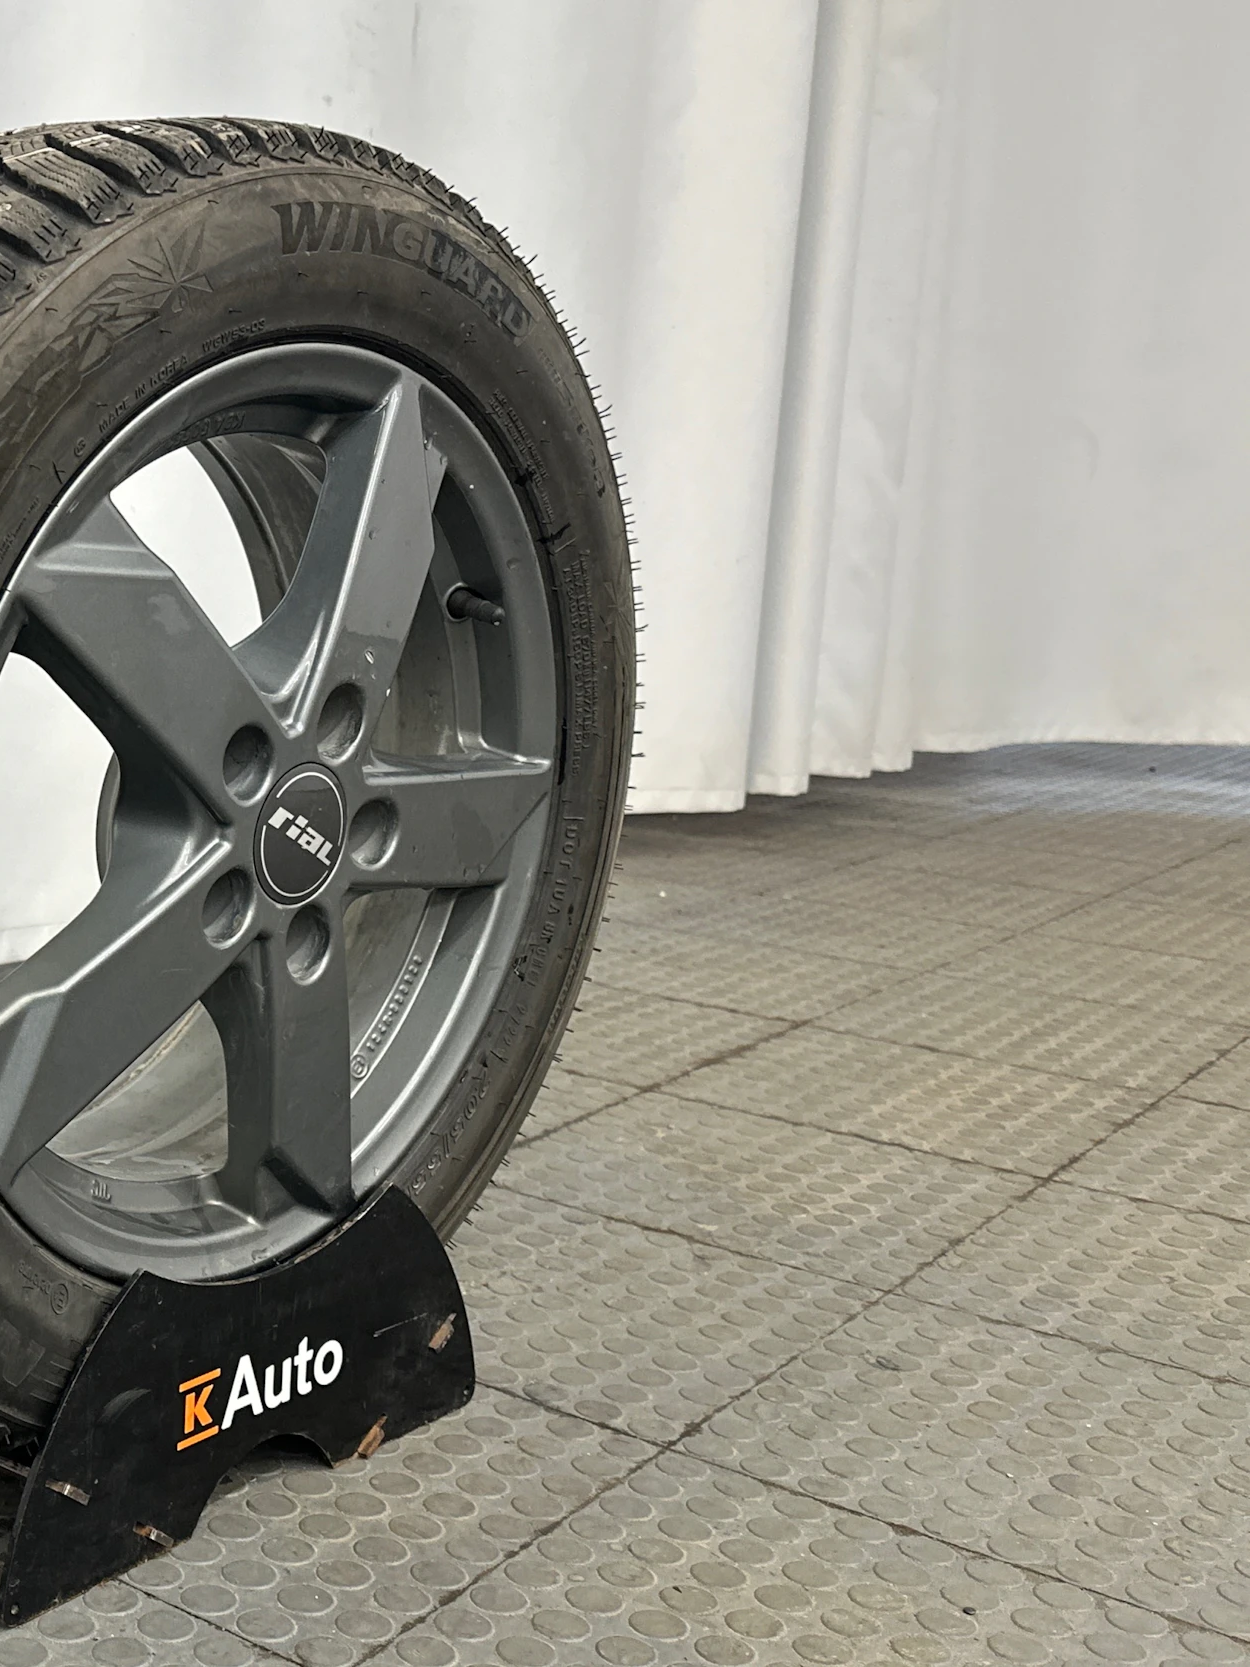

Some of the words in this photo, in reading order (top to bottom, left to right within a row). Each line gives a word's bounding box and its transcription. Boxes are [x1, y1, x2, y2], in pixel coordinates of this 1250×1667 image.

[270, 201, 535, 338] WINGUARD
[99, 397, 131, 433] MADE
[135, 382, 148, 399] IN
[150, 355, 189, 386] KOREA
[558, 823, 579, 869] DOT
[407, 1077, 492, 1197] 205/55
[221, 1336, 343, 1430] Auto
